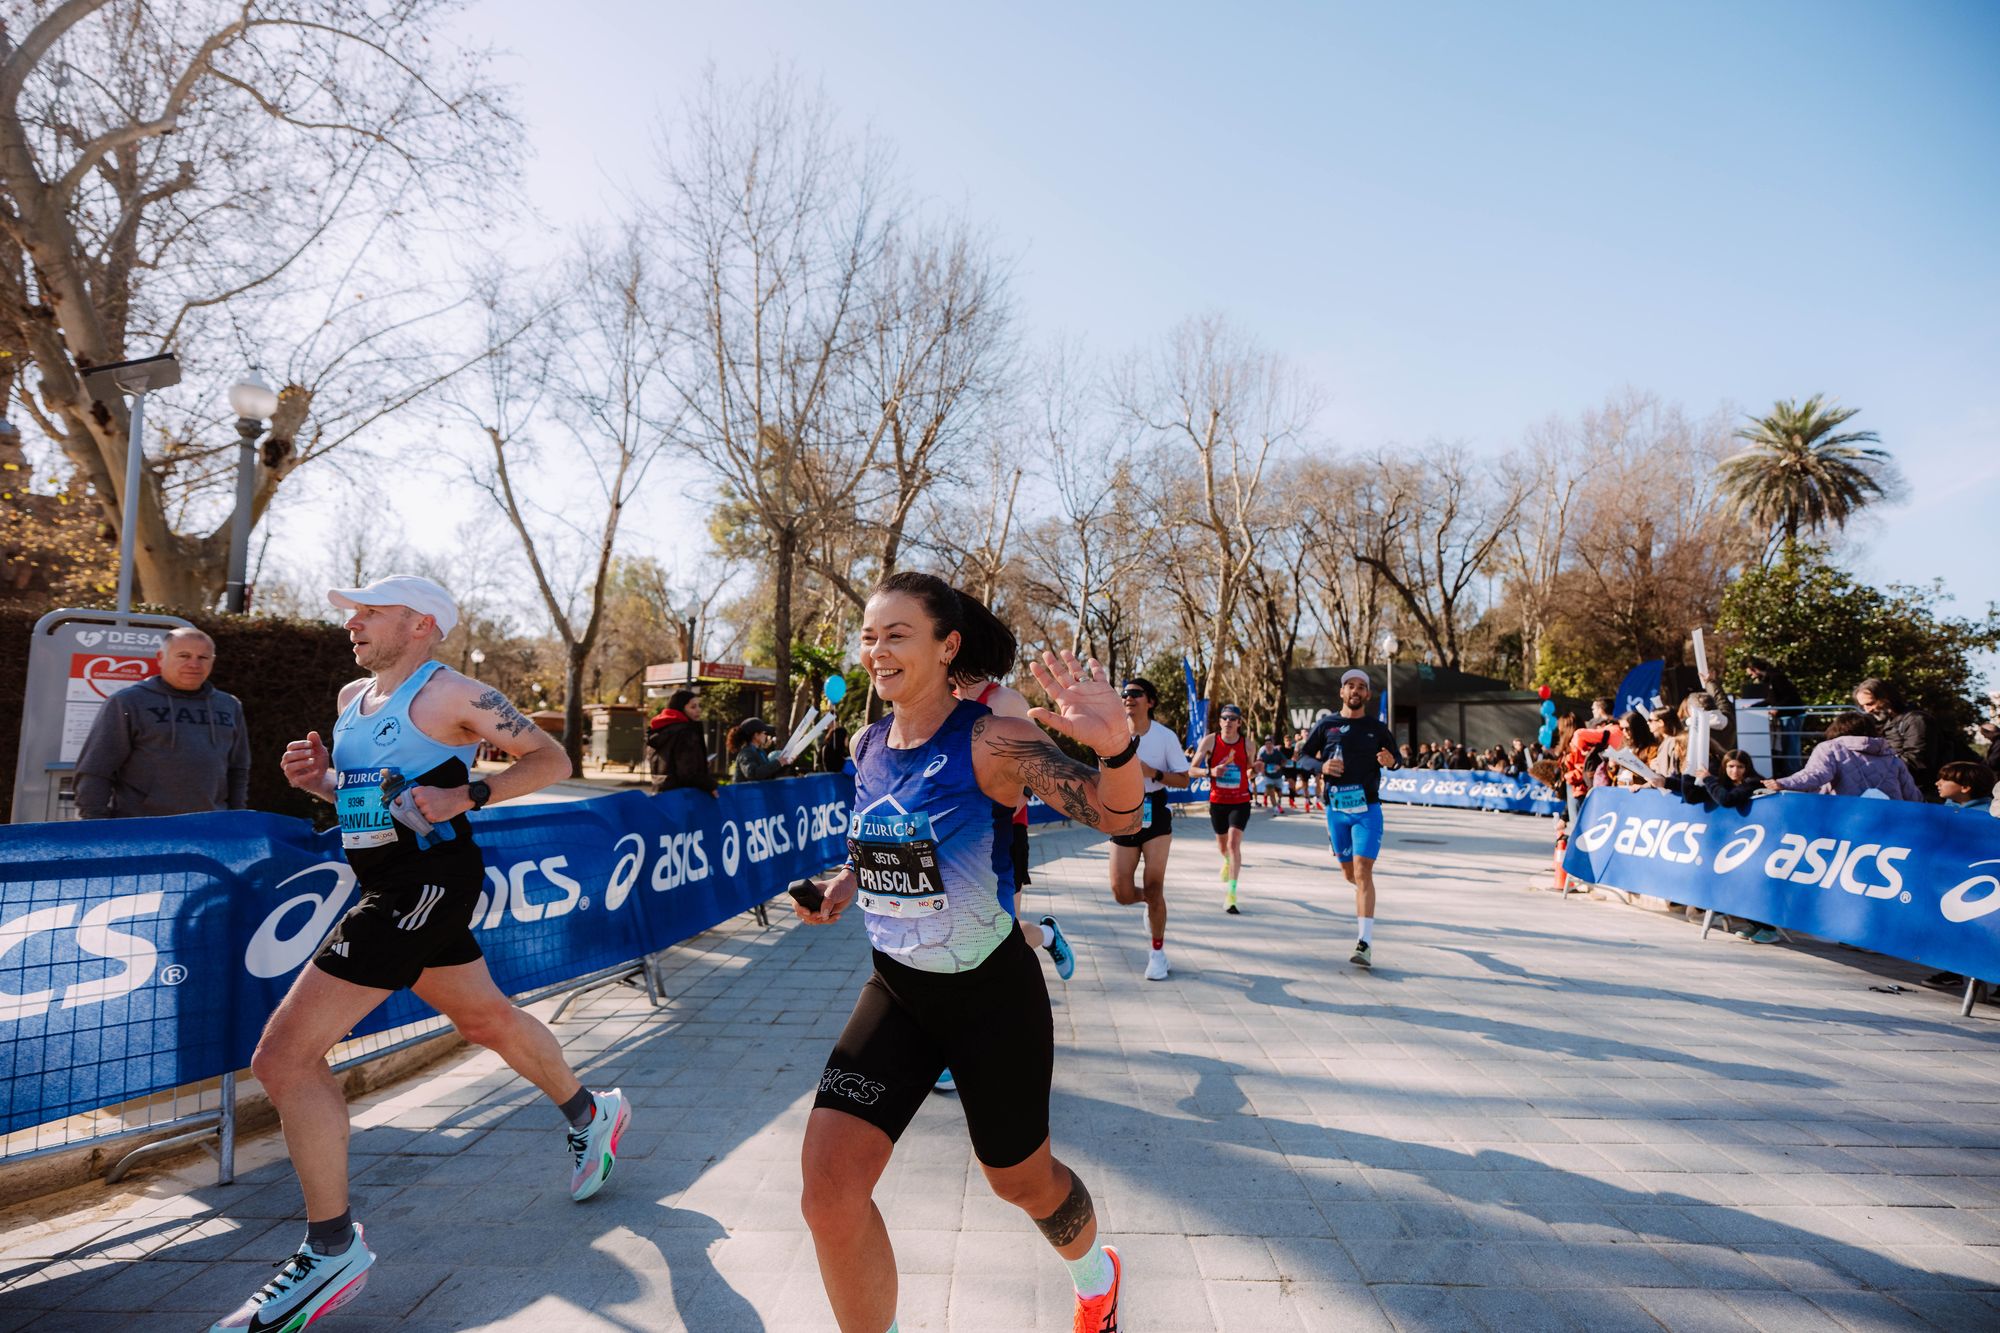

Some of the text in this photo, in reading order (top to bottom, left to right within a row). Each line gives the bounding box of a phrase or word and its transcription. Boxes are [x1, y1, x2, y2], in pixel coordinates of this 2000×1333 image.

[107, 631, 163, 645] DESA
[147, 706, 235, 728] YALE
[347, 796, 365, 808] 9396
[1614, 816, 1707, 865] asics
[872, 851, 900, 865] 3576
[1764, 833, 1912, 900] asics
[860, 867, 934, 894] PRISCILA
